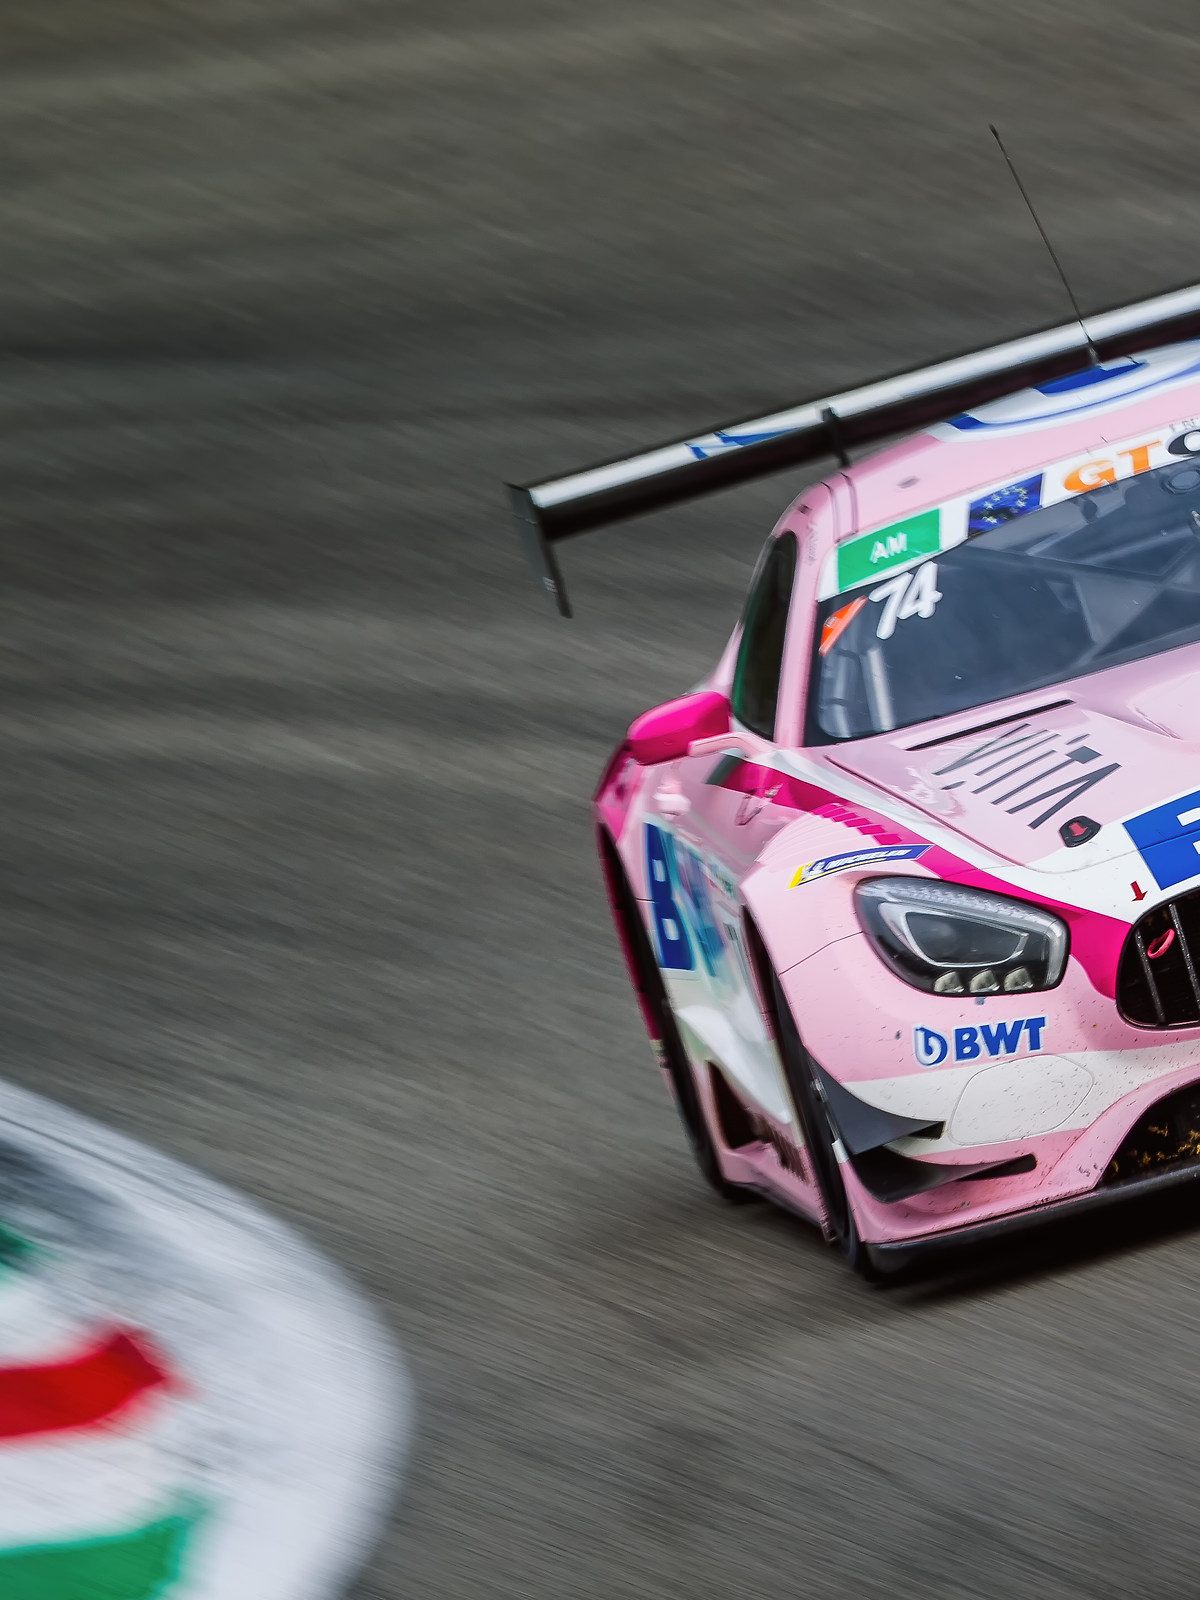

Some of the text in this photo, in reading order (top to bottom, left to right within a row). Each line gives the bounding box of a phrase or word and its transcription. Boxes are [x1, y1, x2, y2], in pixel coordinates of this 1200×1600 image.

[869, 531, 908, 564] AM
[868, 560, 943, 640] 74
[954, 1016, 1046, 1061] BWT
